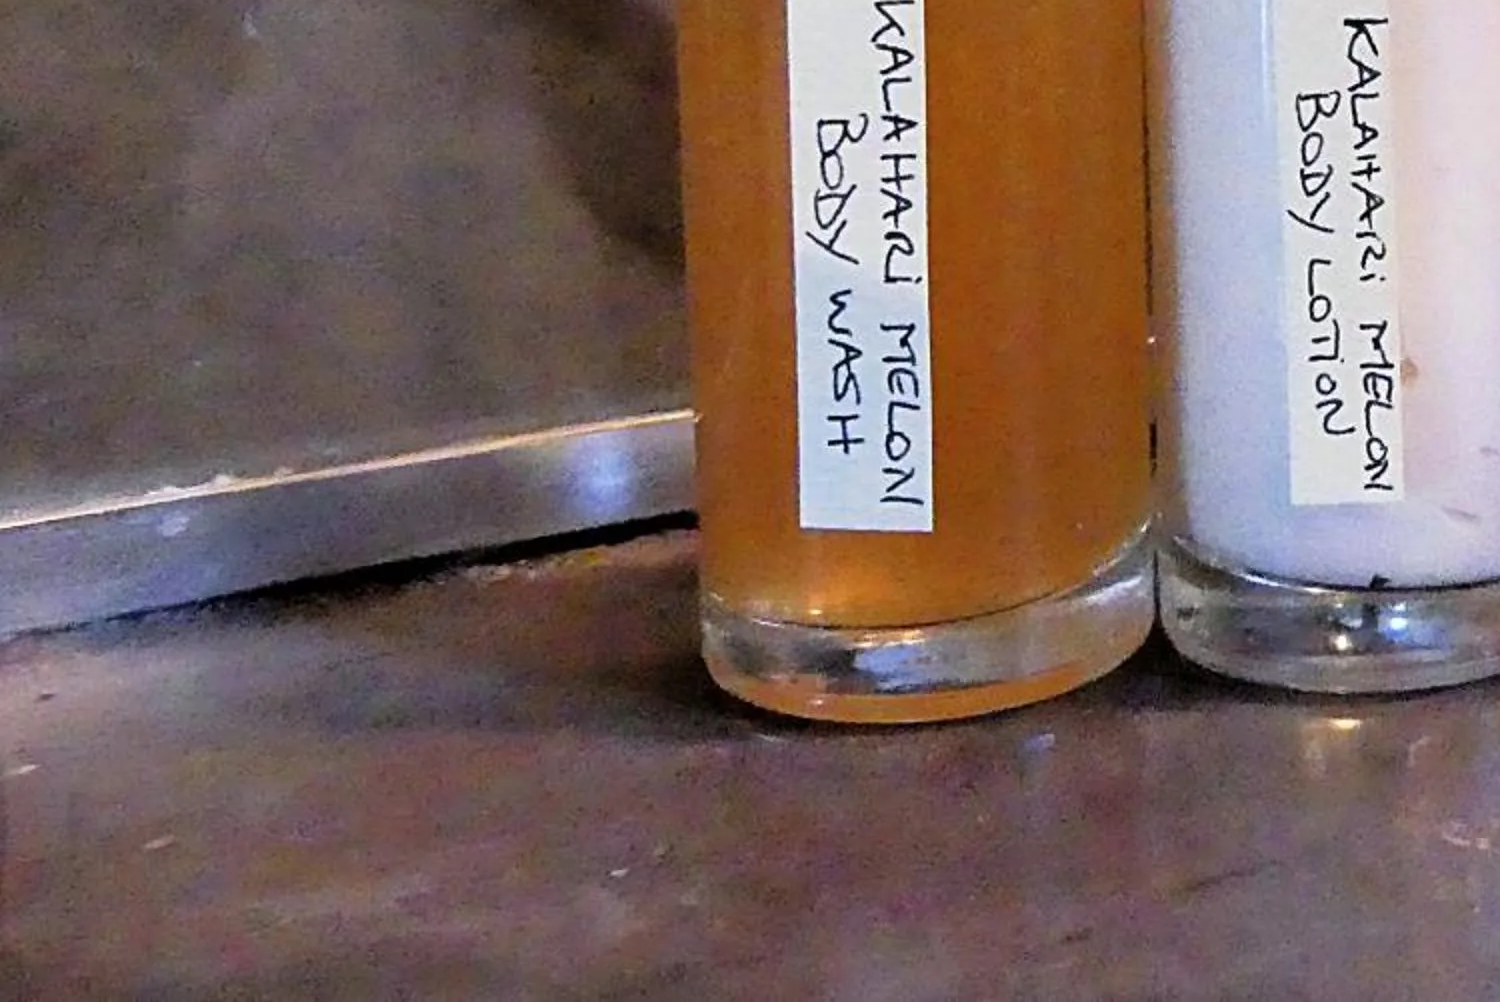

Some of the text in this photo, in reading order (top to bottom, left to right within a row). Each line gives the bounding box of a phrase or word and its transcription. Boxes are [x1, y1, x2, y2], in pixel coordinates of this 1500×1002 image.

[1285, 89, 1343, 235] BODY
[804, 111, 871, 455] BODY WASH
[879, 321, 926, 508] MELON
[1357, 319, 1396, 492] MELON
